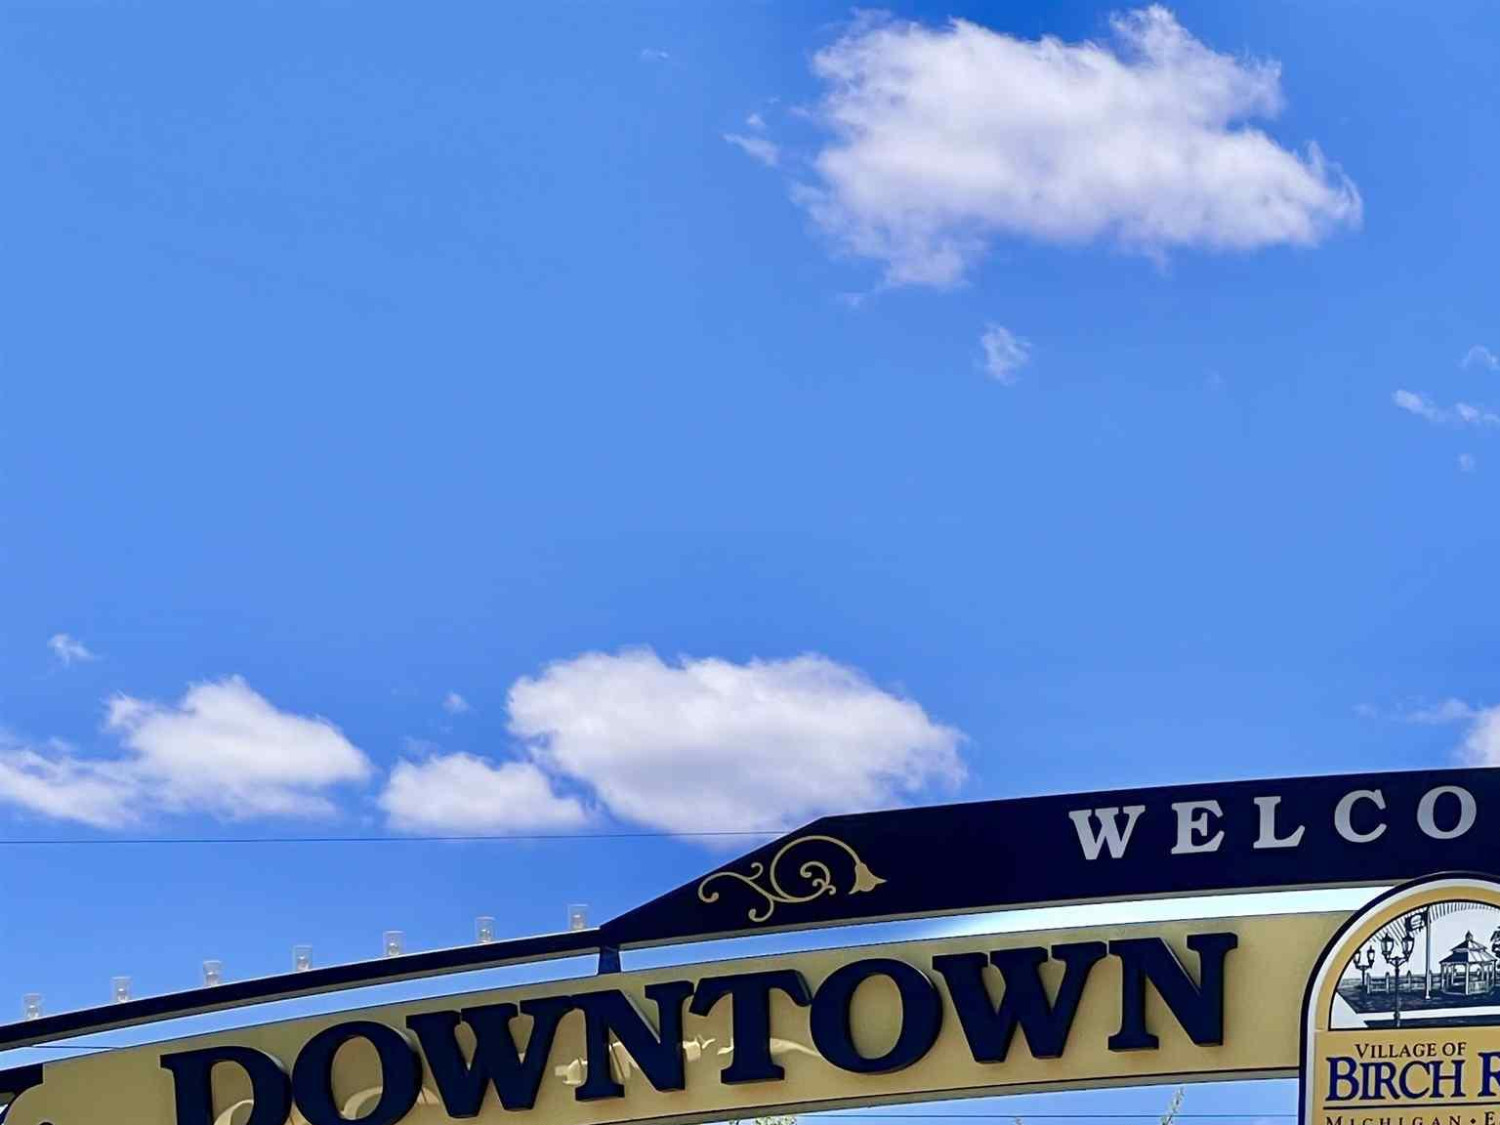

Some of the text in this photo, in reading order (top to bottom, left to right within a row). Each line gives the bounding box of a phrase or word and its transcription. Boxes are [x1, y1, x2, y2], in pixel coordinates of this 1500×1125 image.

[1355, 1042, 1467, 1059] VILLAGE OF
[1325, 1056, 1466, 1102] BIRCH
